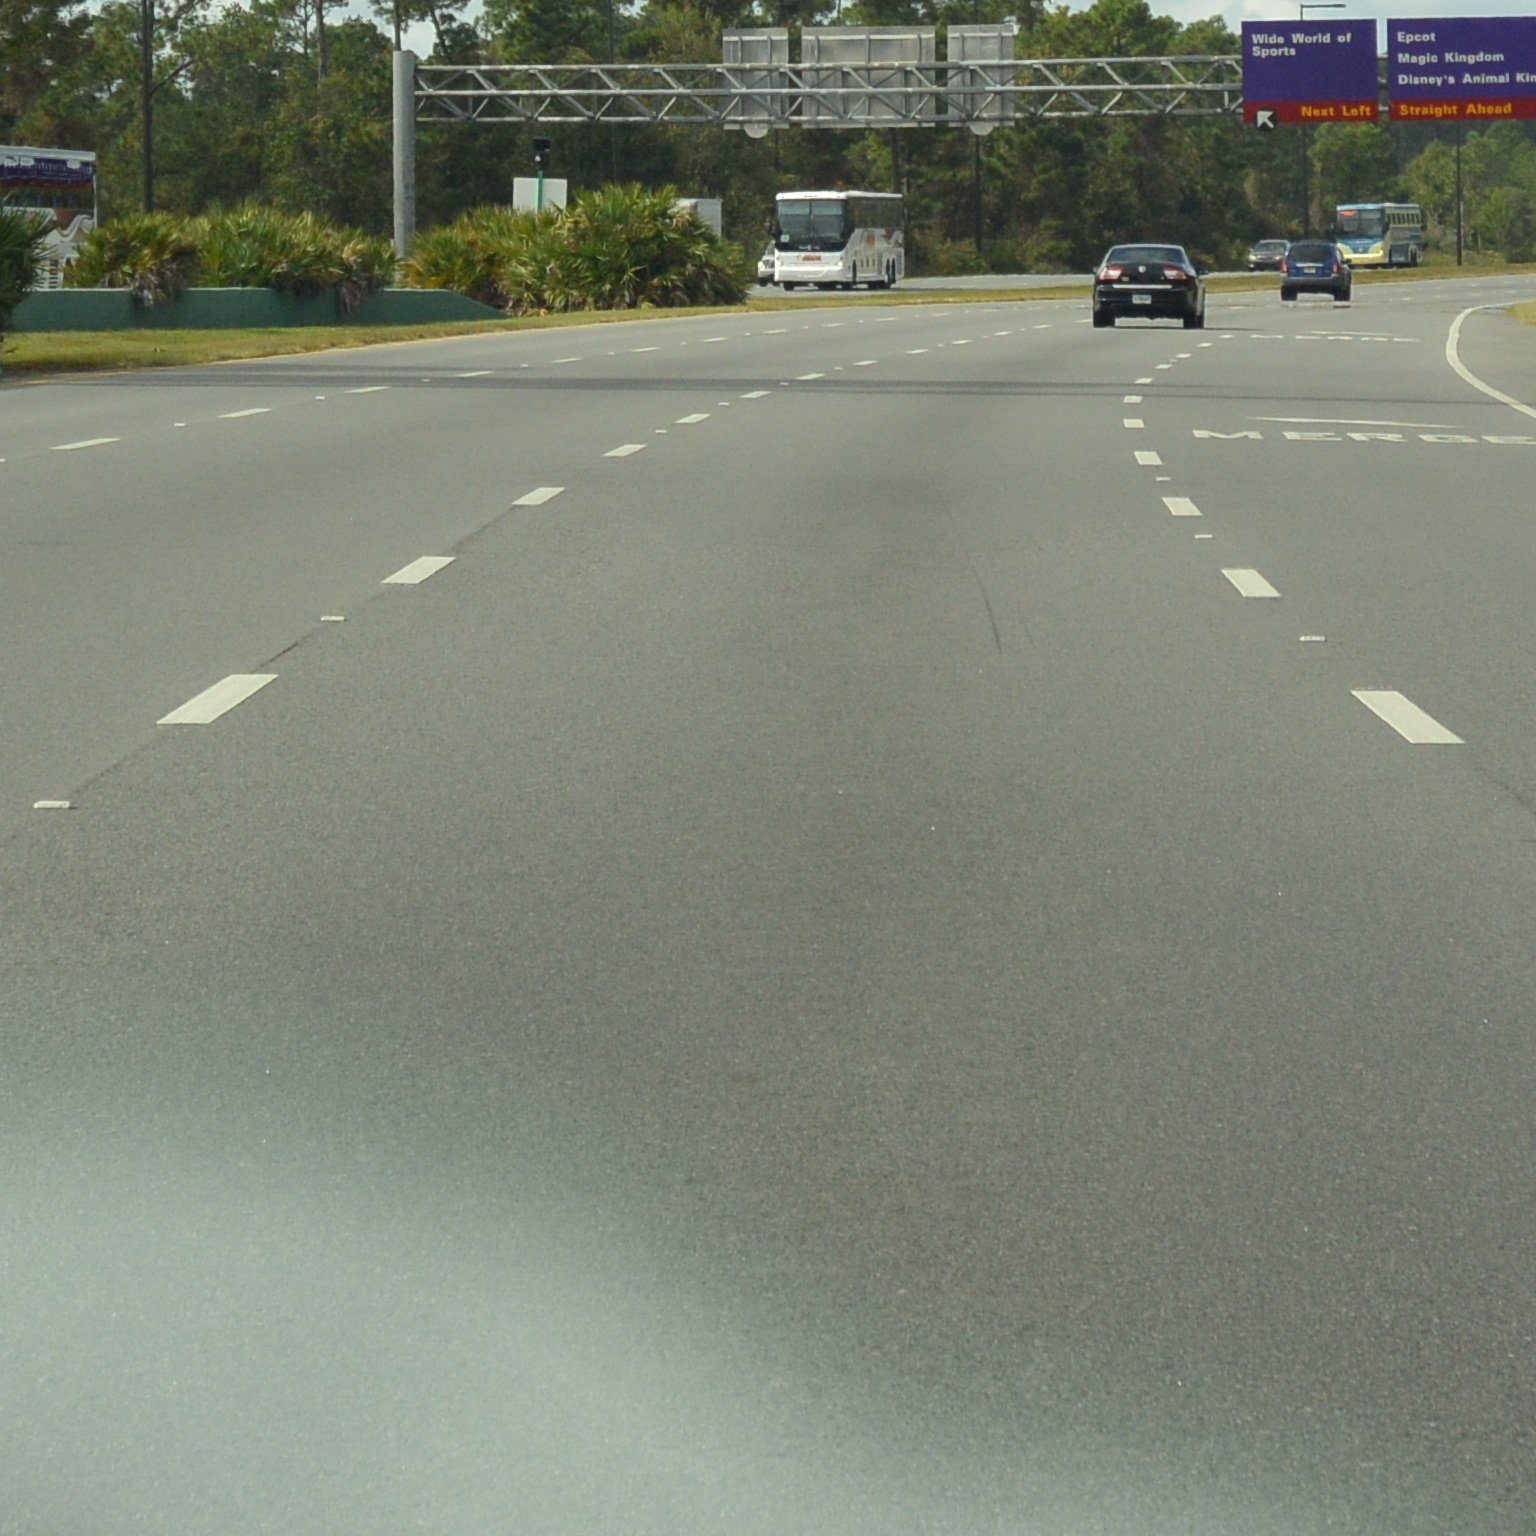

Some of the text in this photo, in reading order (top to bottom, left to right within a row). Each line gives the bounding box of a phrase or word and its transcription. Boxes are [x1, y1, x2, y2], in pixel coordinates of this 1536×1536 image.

[1252, 32, 1352, 44] Wide World of
[1397, 31, 1436, 43] Epcot
[1252, 46, 1296, 58] Sports
[1398, 51, 1504, 65] Magic Kingdom
[1398, 74, 1455, 86] Disney's
[1462, 73, 1509, 84] Animal
[1301, 105, 1371, 117] Next Left
[1399, 102, 1512, 117] Straight Ahead
